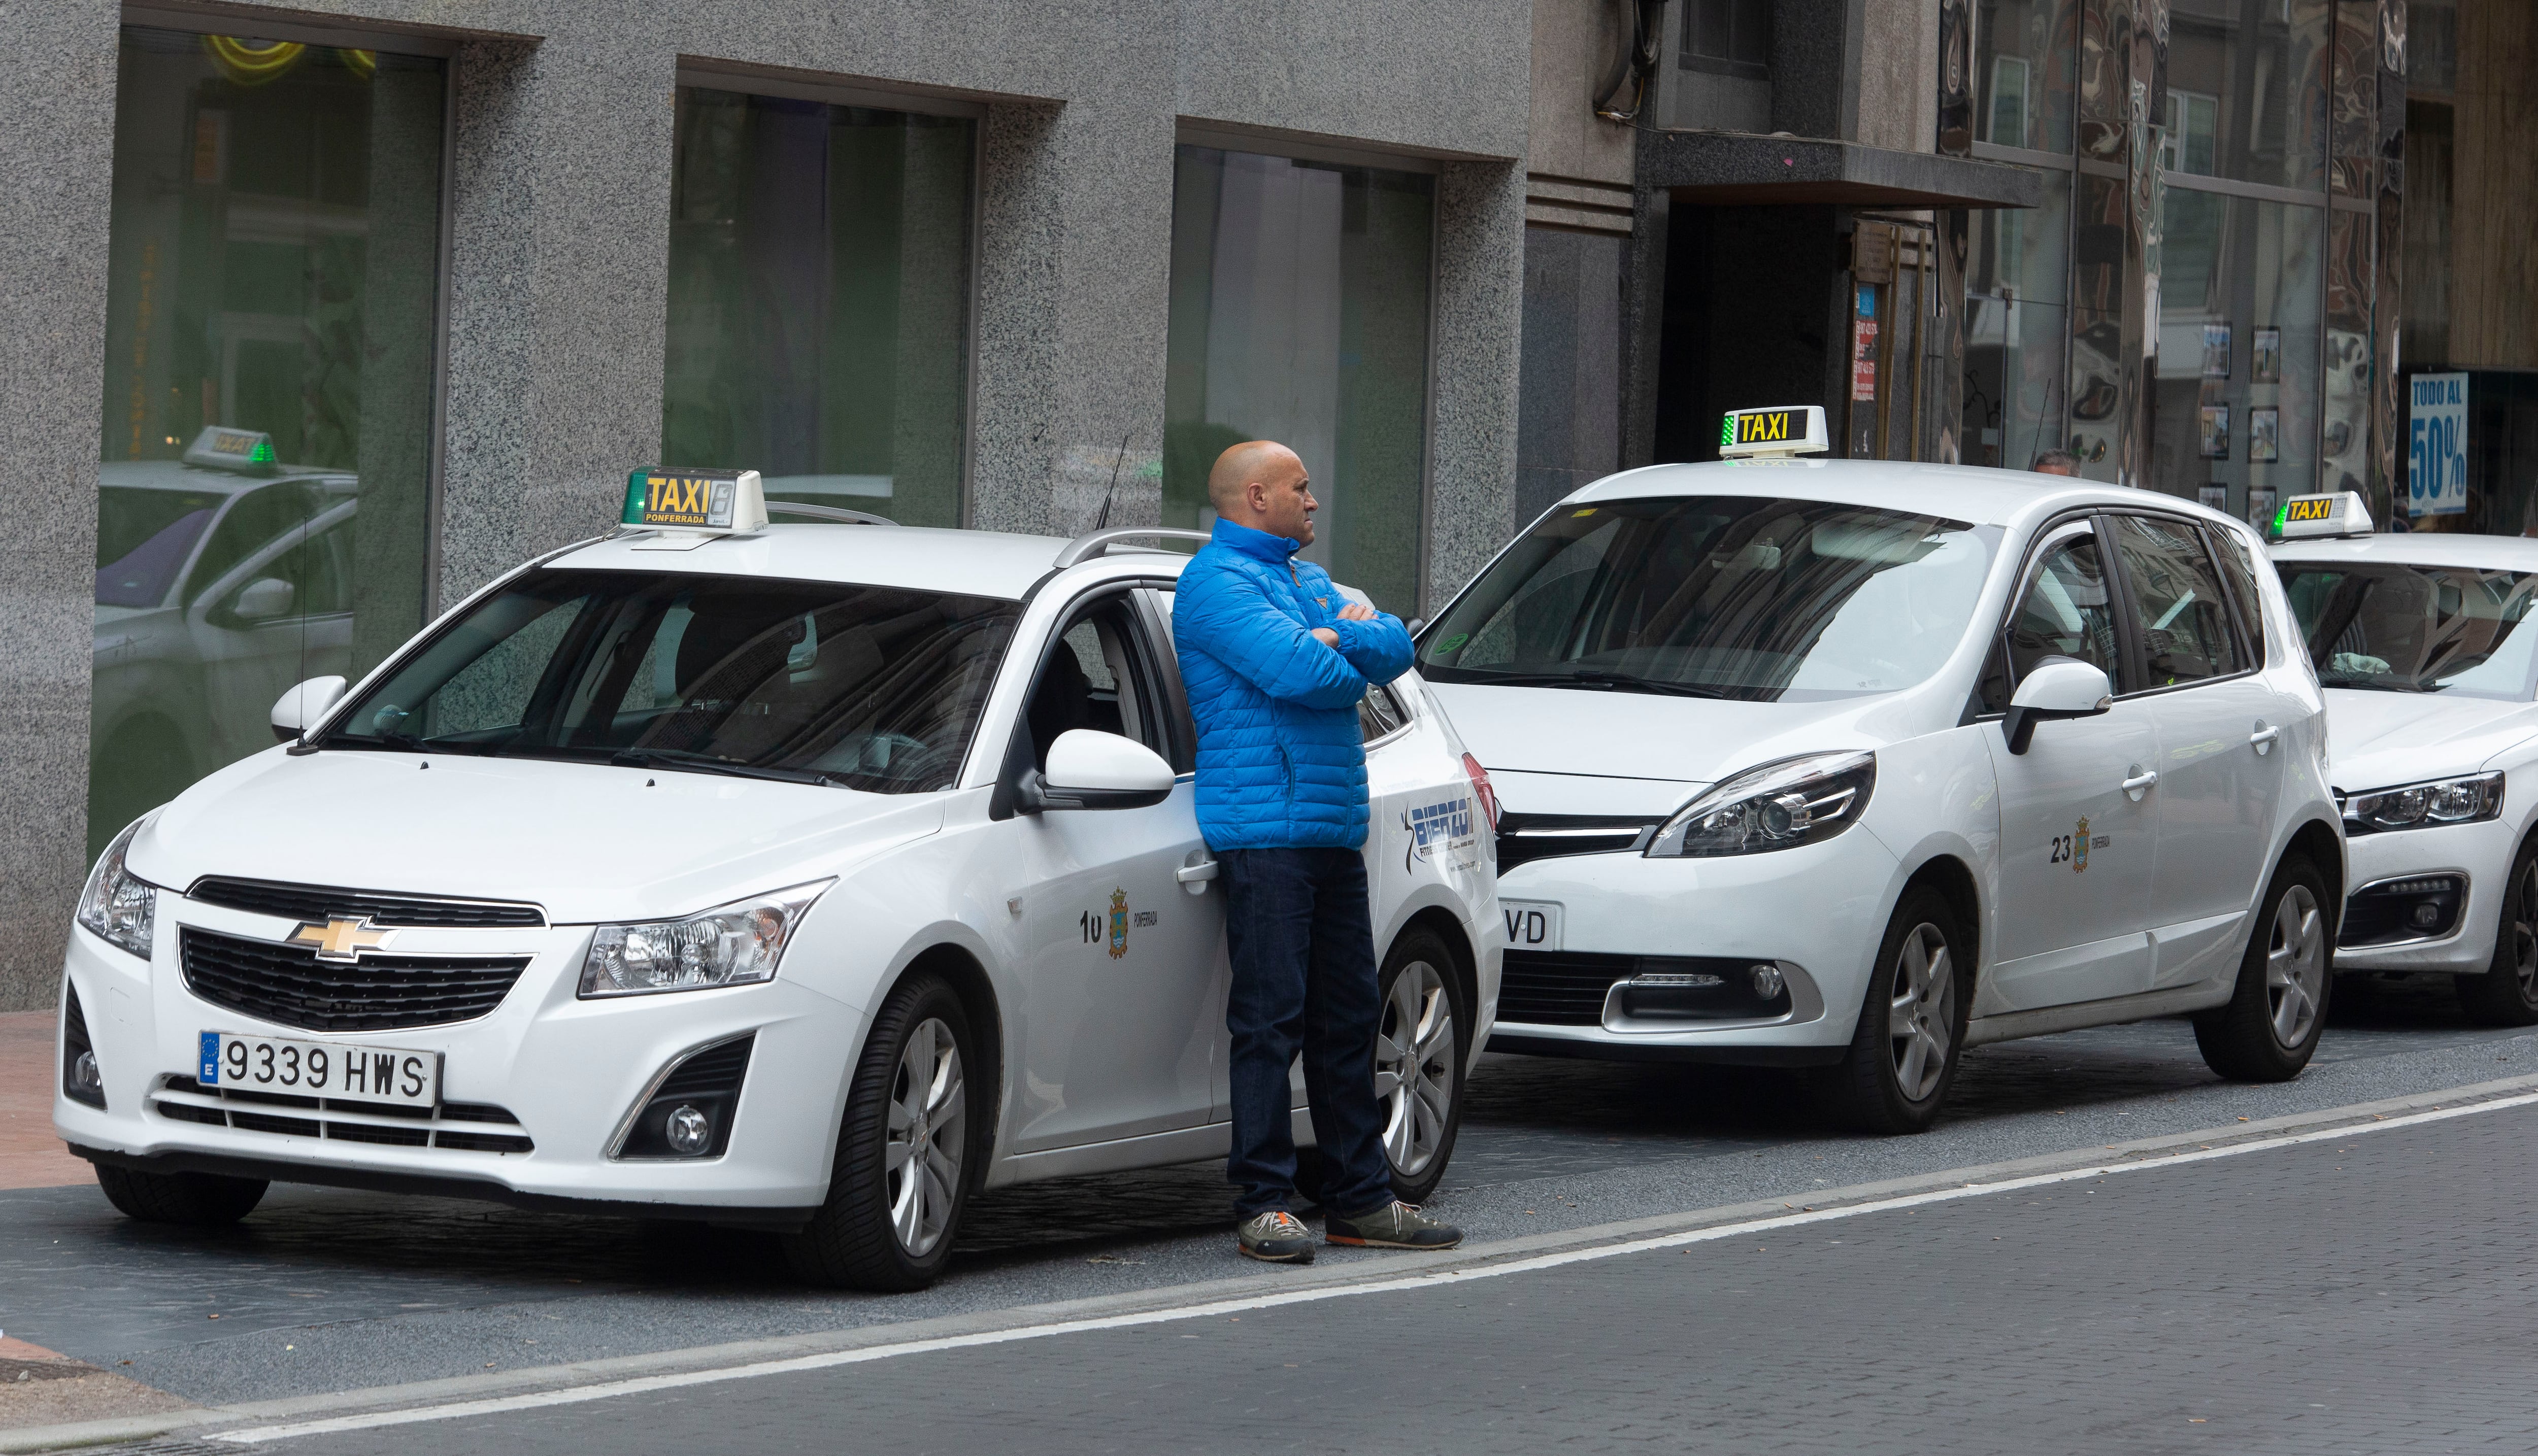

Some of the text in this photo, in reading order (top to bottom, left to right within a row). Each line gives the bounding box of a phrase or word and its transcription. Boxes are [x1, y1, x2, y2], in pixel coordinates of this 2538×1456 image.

[2413, 380, 2462, 406] TODO AL
[1740, 413, 1788, 442] TAXI
[2411, 415, 2465, 499] 50%
[648, 478, 711, 514] TAXI
[2291, 499, 2330, 520] TAXI
[646, 514, 705, 524] PONFERRADA
[1412, 798, 1468, 846] BIERZO
[2051, 835, 2070, 863] 23
[1080, 910, 1101, 943] 10
[1134, 911, 1157, 928] PONFERRADA
[1505, 909, 1546, 943] VD
[205, 1064, 214, 1075] E
[227, 1040, 424, 1097] 9339 HWS
